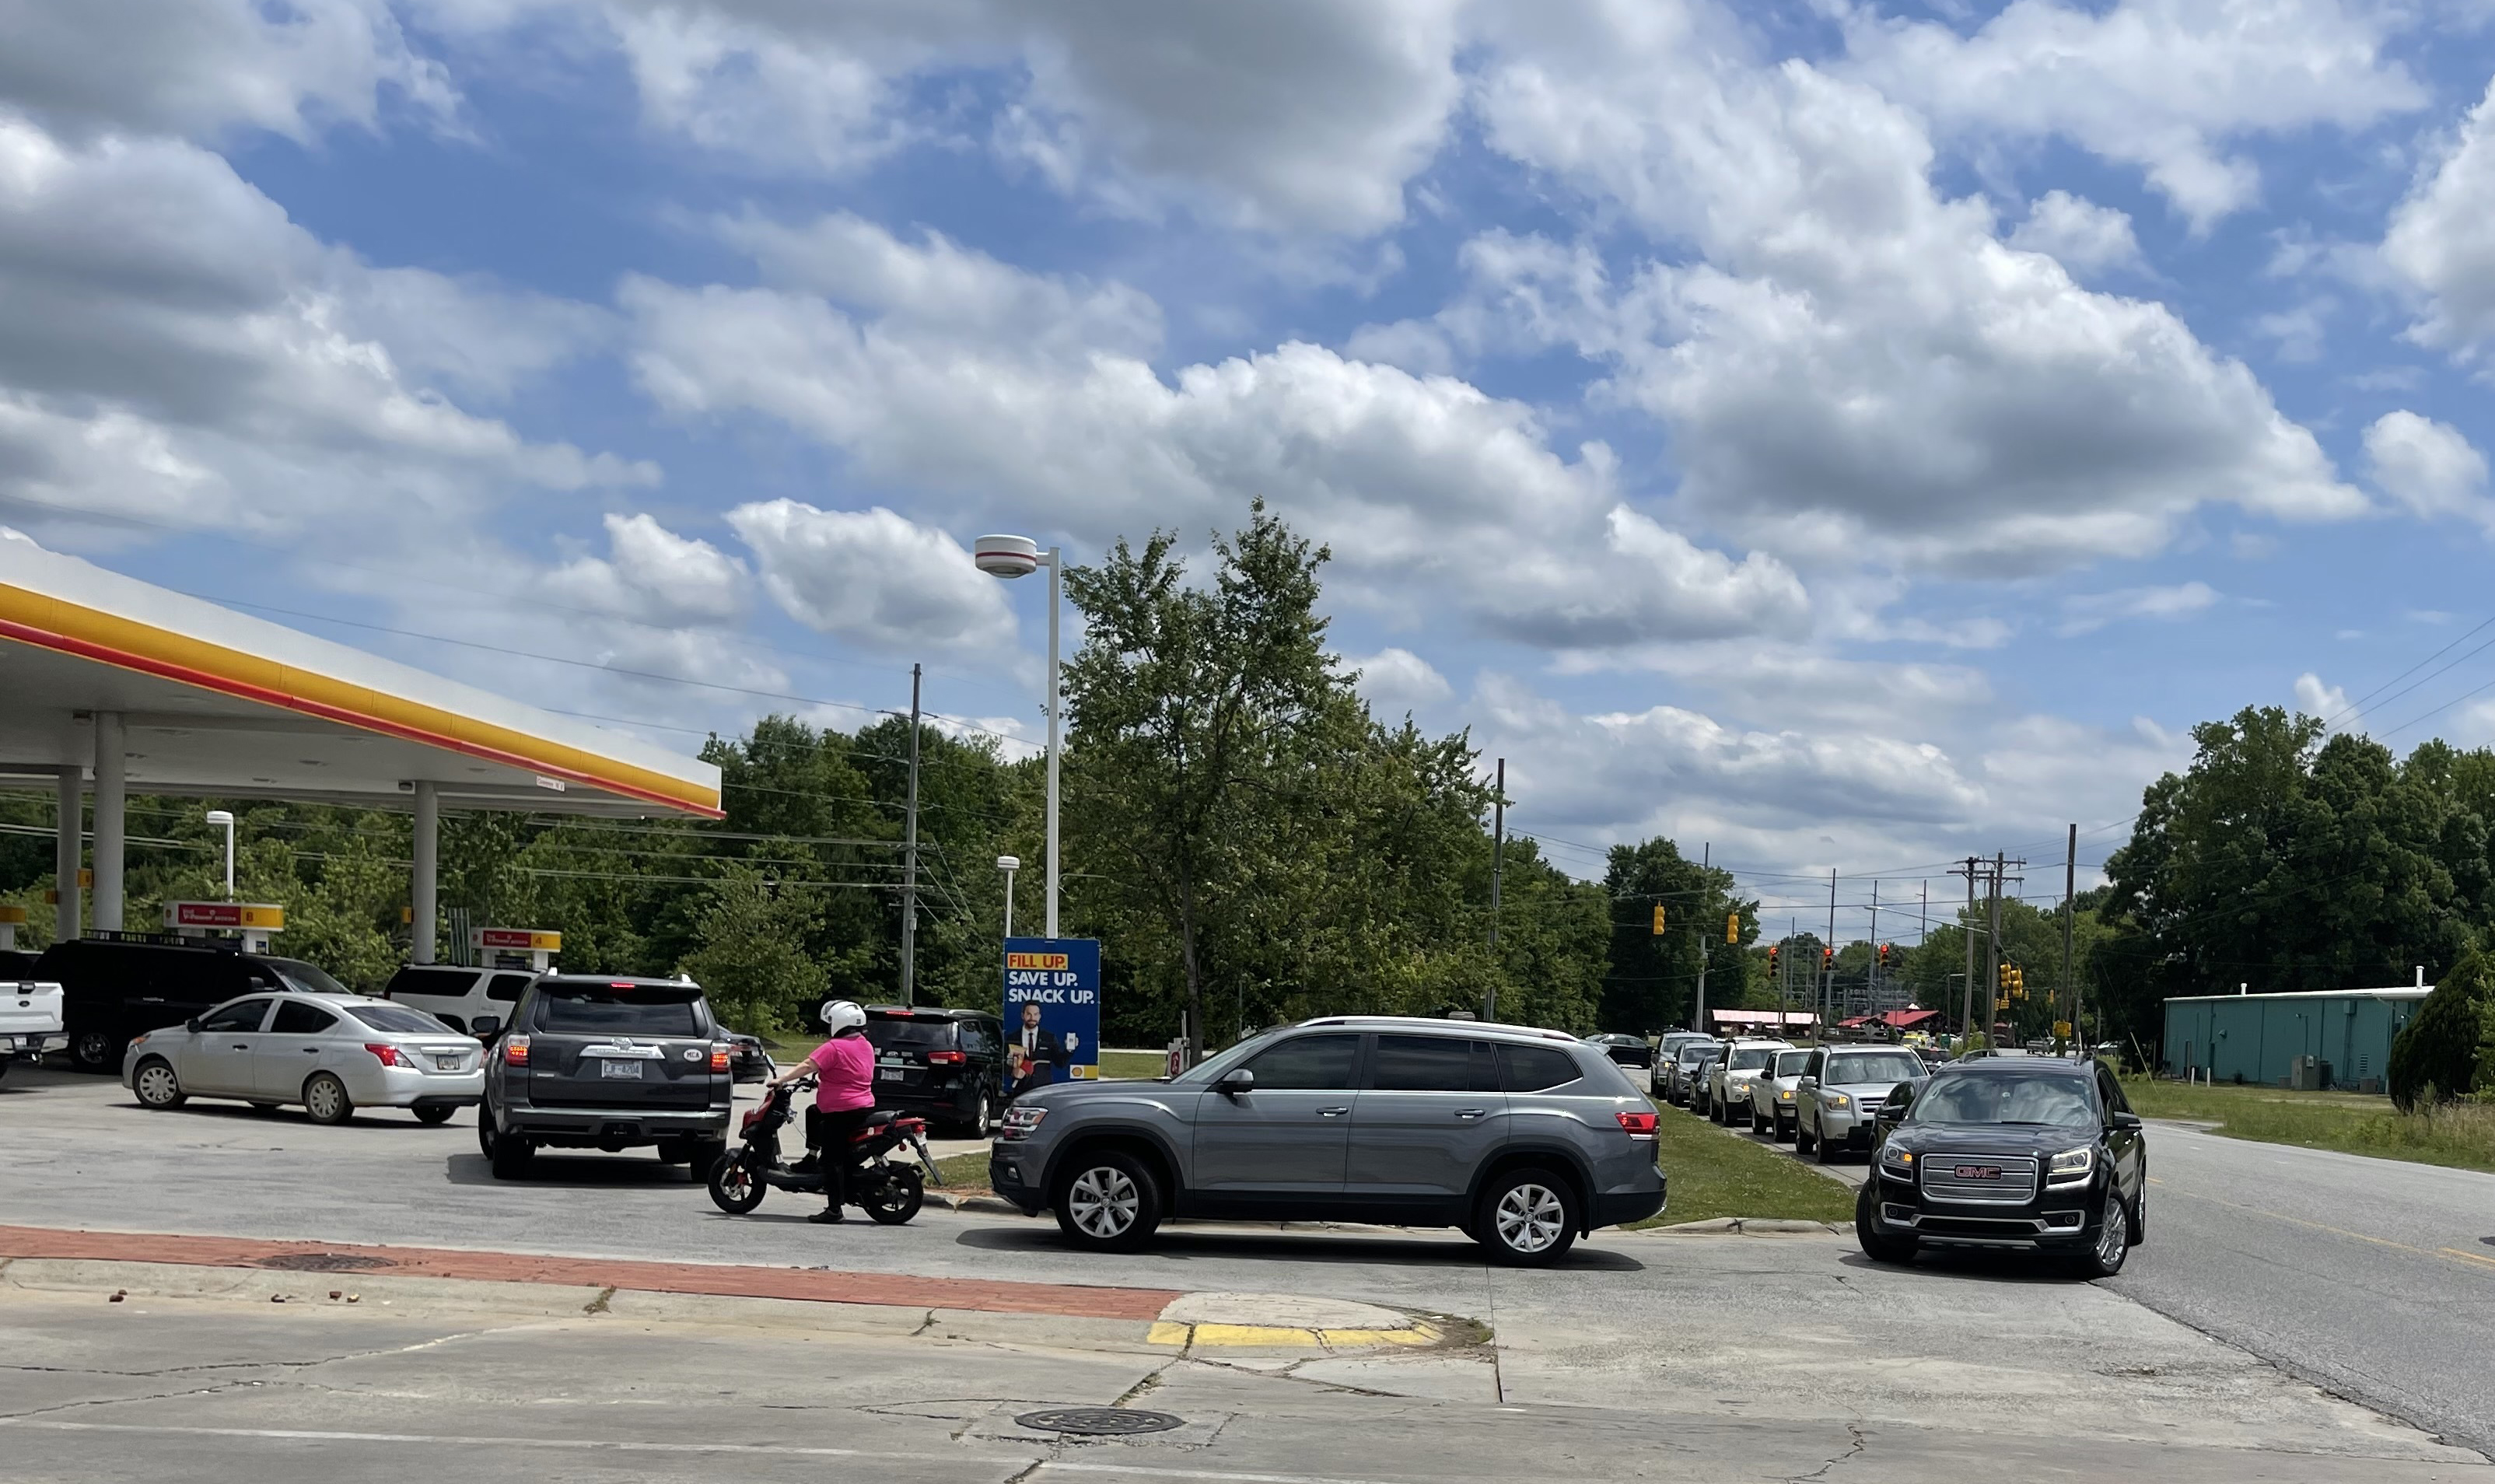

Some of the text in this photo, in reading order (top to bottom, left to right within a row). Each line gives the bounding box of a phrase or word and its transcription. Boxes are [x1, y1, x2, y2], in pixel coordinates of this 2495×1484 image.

[1009, 954, 1066, 968] FILL UP.
[1008, 971, 1078, 986] SAVE UP.
[1008, 988, 1095, 1004] SNACK UP.
[1955, 1166, 2000, 1178] GMC
